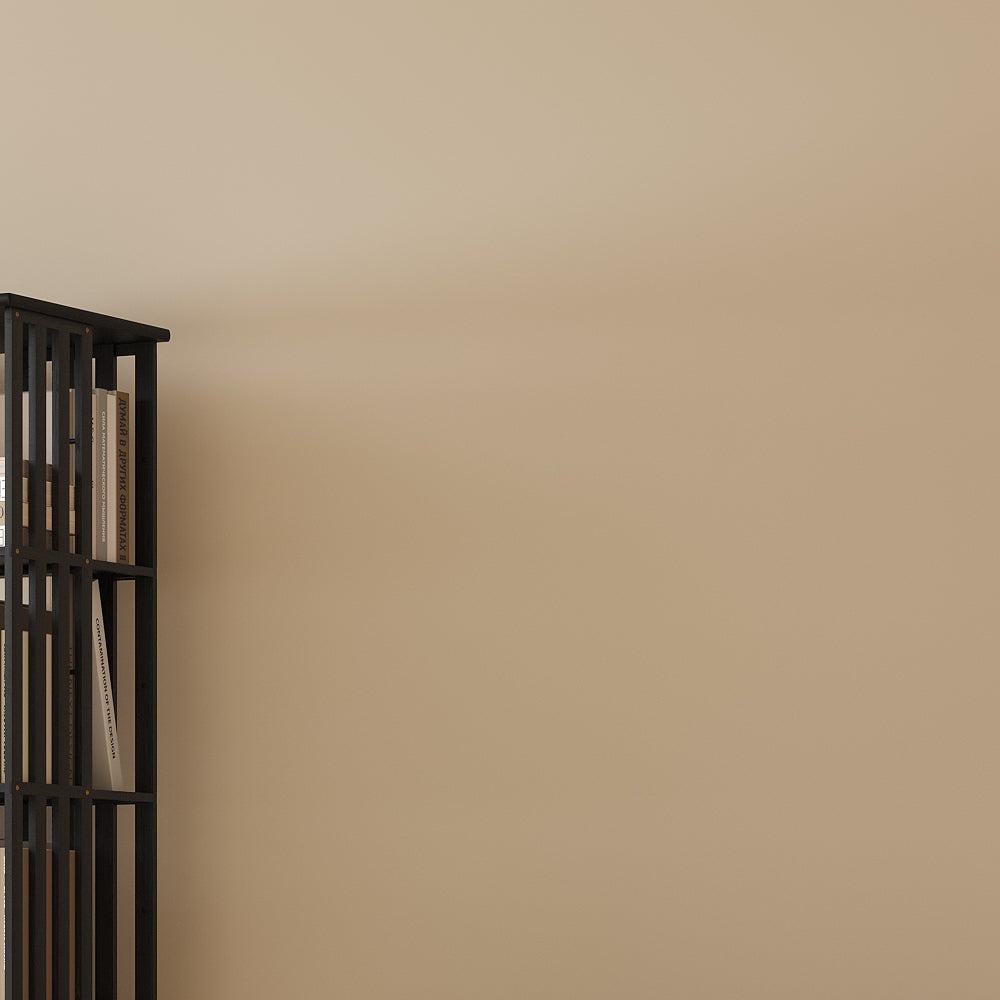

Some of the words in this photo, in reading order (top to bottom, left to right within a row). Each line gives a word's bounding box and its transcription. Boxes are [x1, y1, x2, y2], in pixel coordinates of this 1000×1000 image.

[119, 397, 127, 436] ДУМАЙ
[119, 449, 127, 491] ДРУГИХ
[119, 494, 127, 551] ФОРМАТАХ
[95, 618, 107, 693] CONTAMINATION
[108, 726, 116, 759] DESIGN
